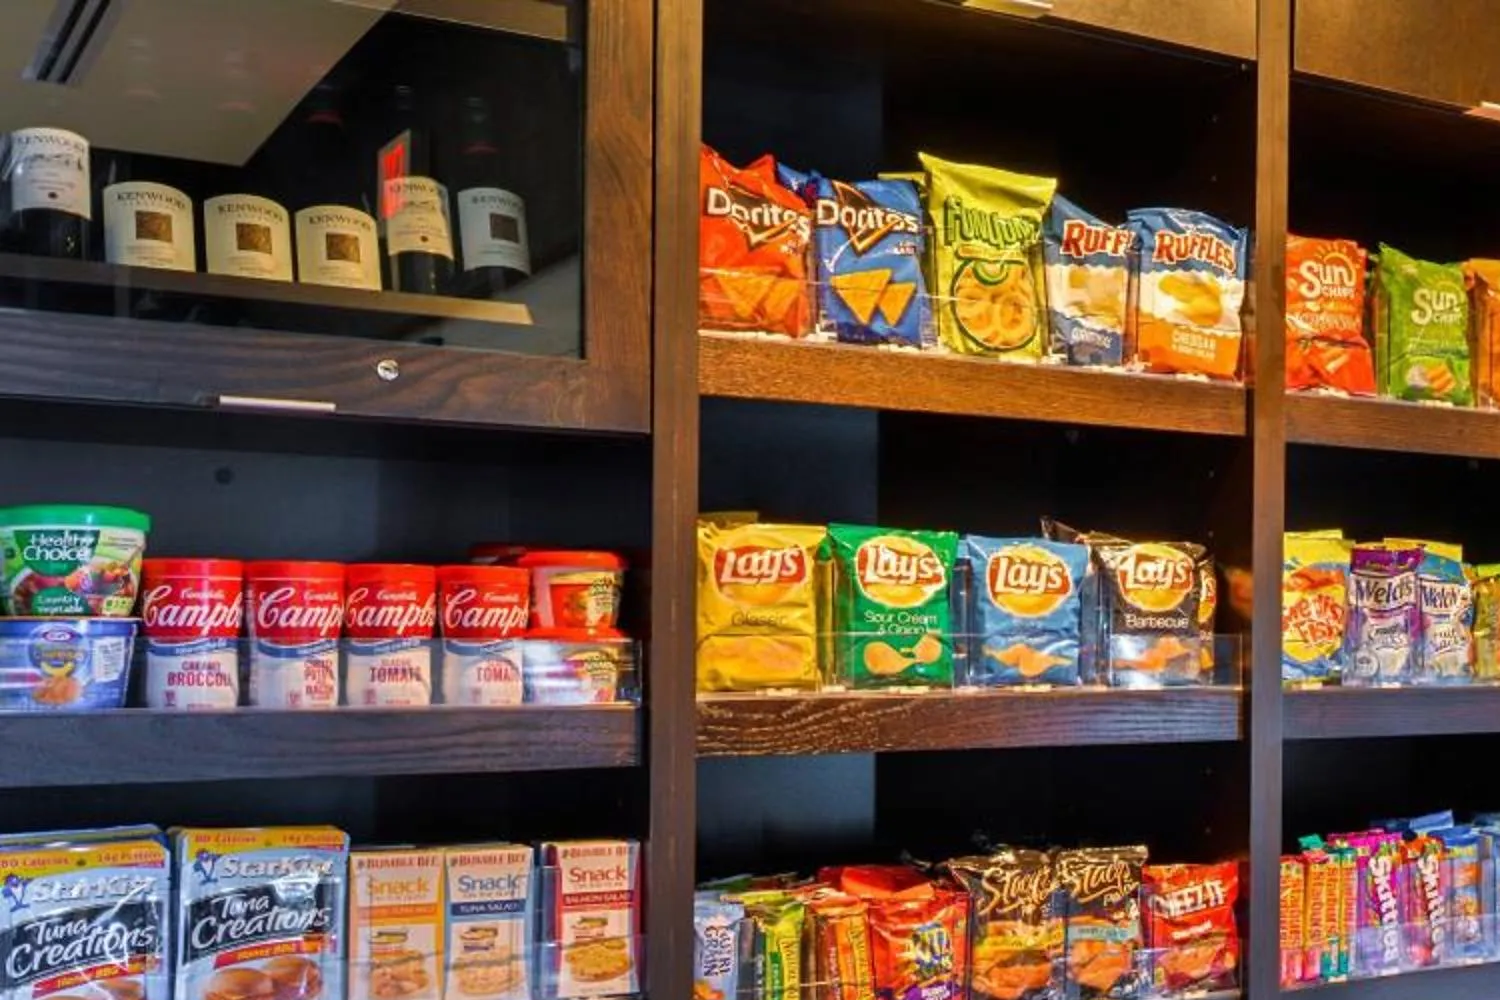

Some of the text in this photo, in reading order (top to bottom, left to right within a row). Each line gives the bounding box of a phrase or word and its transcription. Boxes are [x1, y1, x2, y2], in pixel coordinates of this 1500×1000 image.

[117, 189, 186, 211] KENWOOD
[218, 203, 284, 223] KENWOOD
[707, 187, 811, 243] Doritos
[309, 213, 371, 232] KENWOOD
[816, 199, 919, 233] Doritos
[1060, 218, 1136, 258] RUFFL
[1153, 229, 1237, 273] RUFFLES
[1300, 260, 1356, 298] Sun
[1411, 288, 1459, 325] Sun
[23, 542, 91, 562] Choice
[28, 530, 95, 550] Healthy
[719, 544, 801, 585] Lay's
[864, 543, 938, 586] Lay's
[995, 556, 1065, 594] Lay's
[1116, 556, 1189, 591] Lay's
[1421, 583, 1459, 610] Welch
[864, 611, 939, 625] Sour Cream
[1124, 614, 1190, 629] Barbecue
[476, 667, 513, 683] TOMA
[220, 855, 334, 880] StarKist
[366, 856, 415, 870] BUMBLE
[569, 865, 627, 884] Snack
[368, 877, 429, 895] Snack
[457, 874, 520, 892] Snack
[978, 864, 1053, 916] Stacy's
[1071, 860, 1132, 903] Stacy's
[213, 893, 270, 919] Tuna
[460, 902, 519, 912] TUNA SALAD
[1369, 854, 1400, 962] Skittles
[26, 917, 91, 946] Tuna
[192, 905, 330, 950] Creations
[6, 921, 155, 978] Creations
[703, 925, 720, 977] GRAIN
[781, 939, 800, 985] NATURE
